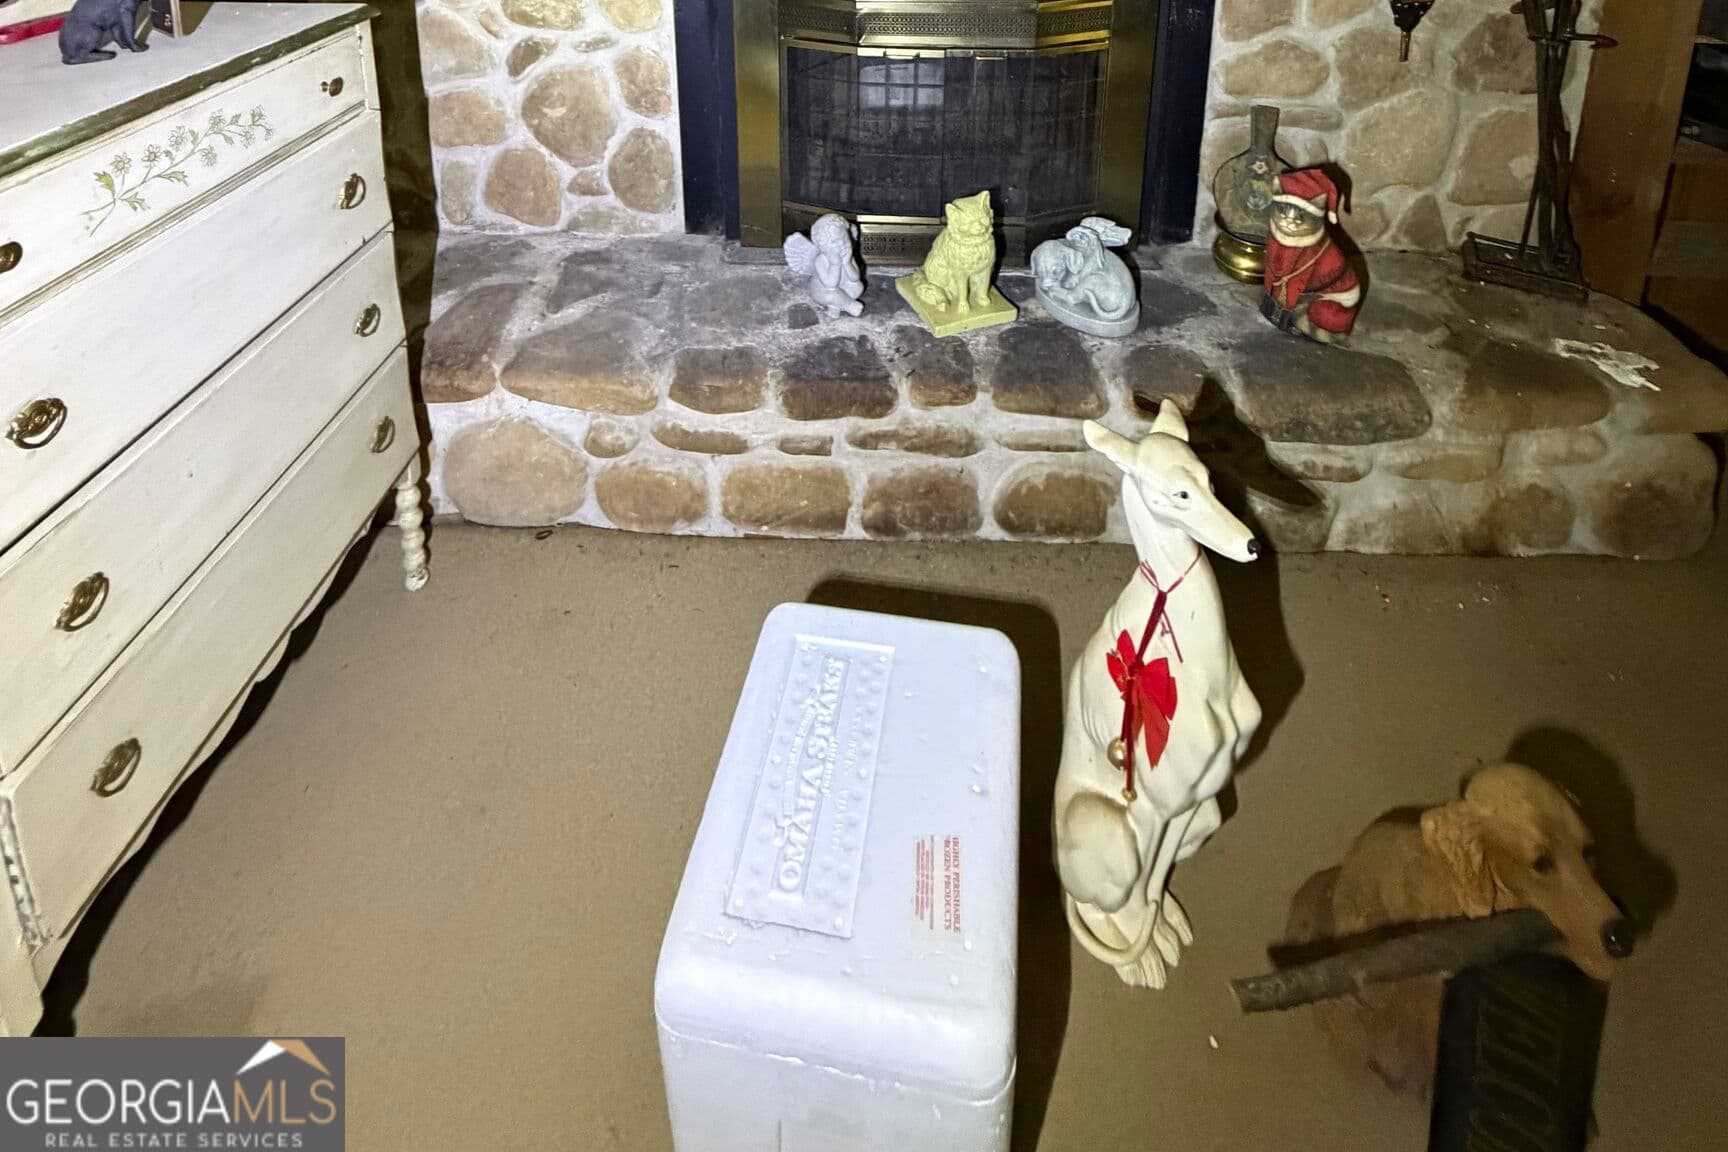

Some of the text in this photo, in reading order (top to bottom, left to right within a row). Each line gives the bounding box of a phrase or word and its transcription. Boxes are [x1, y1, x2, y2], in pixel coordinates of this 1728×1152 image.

[778, 764, 824, 890] OMAHA
[806, 659, 844, 759] STEAKS
[944, 874, 952, 930] PRODUCTS
[952, 871, 961, 933] PERISHABLE
